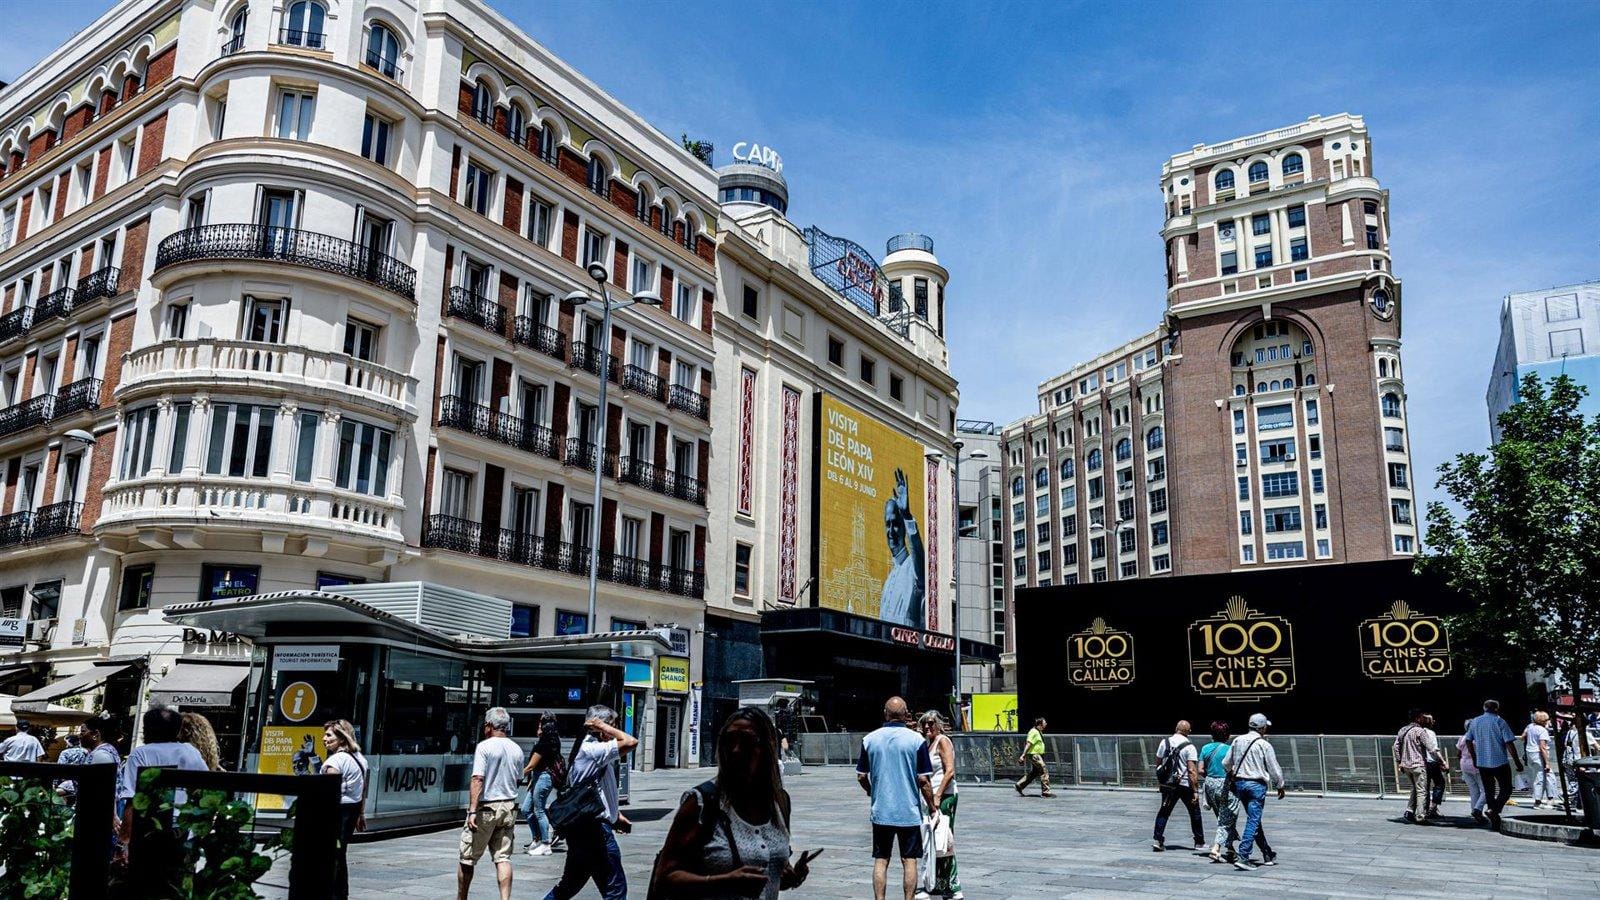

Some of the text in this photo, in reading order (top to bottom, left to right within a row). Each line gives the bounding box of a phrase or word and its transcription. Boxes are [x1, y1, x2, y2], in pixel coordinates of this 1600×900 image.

[828, 408, 858, 436] VISITA
[828, 427, 873, 463] DEL PAPA
[828, 448, 874, 482] LEÓN XIV
[827, 469, 877, 498] DEL 6 AL 9 JUNIO
[219, 580, 246, 588] EN EL
[890, 626, 955, 651] CINES CALLAO
[1199, 621, 1282, 655] 100
[1368, 620, 1439, 647] 100
[1073, 635, 1127, 659] 100
[1383, 647, 1427, 658] CINES
[661, 666, 685, 675] CAMBIO
[1073, 667, 1130, 682] CALLAO
[1084, 658, 1117, 668] CINES
[1215, 656, 1266, 669] CINES
[1368, 658, 1445, 674] CALLAO
[660, 674, 686, 682] CHANGE
[1198, 669, 1288, 689] CALLAO
[668, 732, 676, 758] CAMBIO
[384, 766, 438, 793] MADRID
